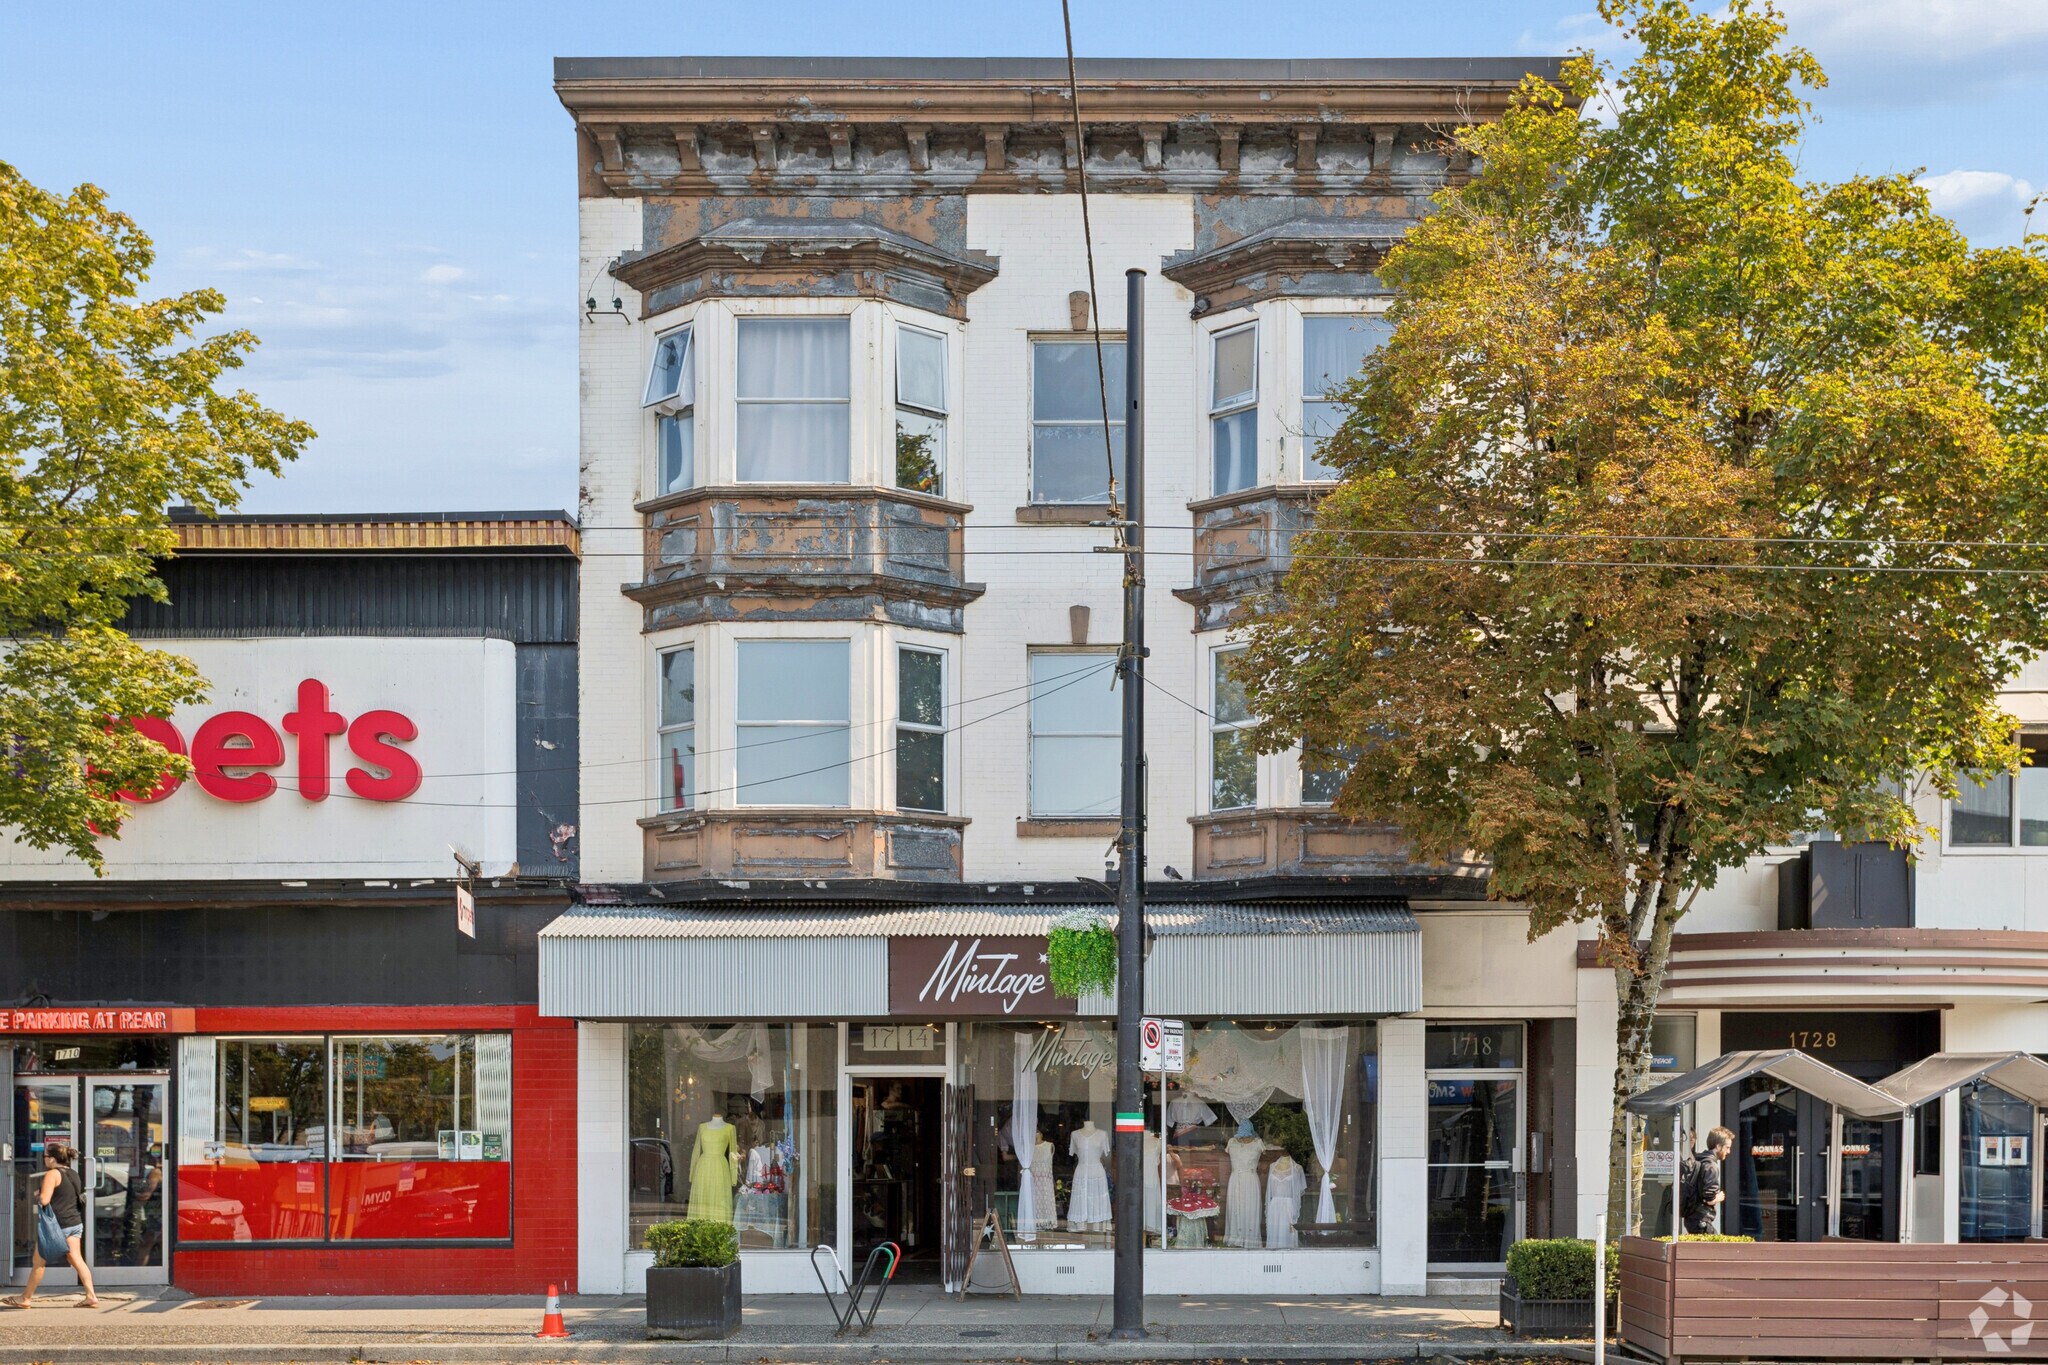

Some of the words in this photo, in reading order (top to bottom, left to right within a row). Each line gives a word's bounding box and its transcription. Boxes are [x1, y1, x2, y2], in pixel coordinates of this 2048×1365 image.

[13, 1012, 91, 1029] PARKING
[93, 1012, 116, 1029] AT
[119, 1012, 167, 1030] REAR
[870, 1028, 929, 1049] 1714
[1452, 1036, 1492, 1056] 1718
[1789, 1031, 1837, 1048] 1728
[57, 1048, 80, 1060] 1710
[332, 1058, 351, 1066] Slf
